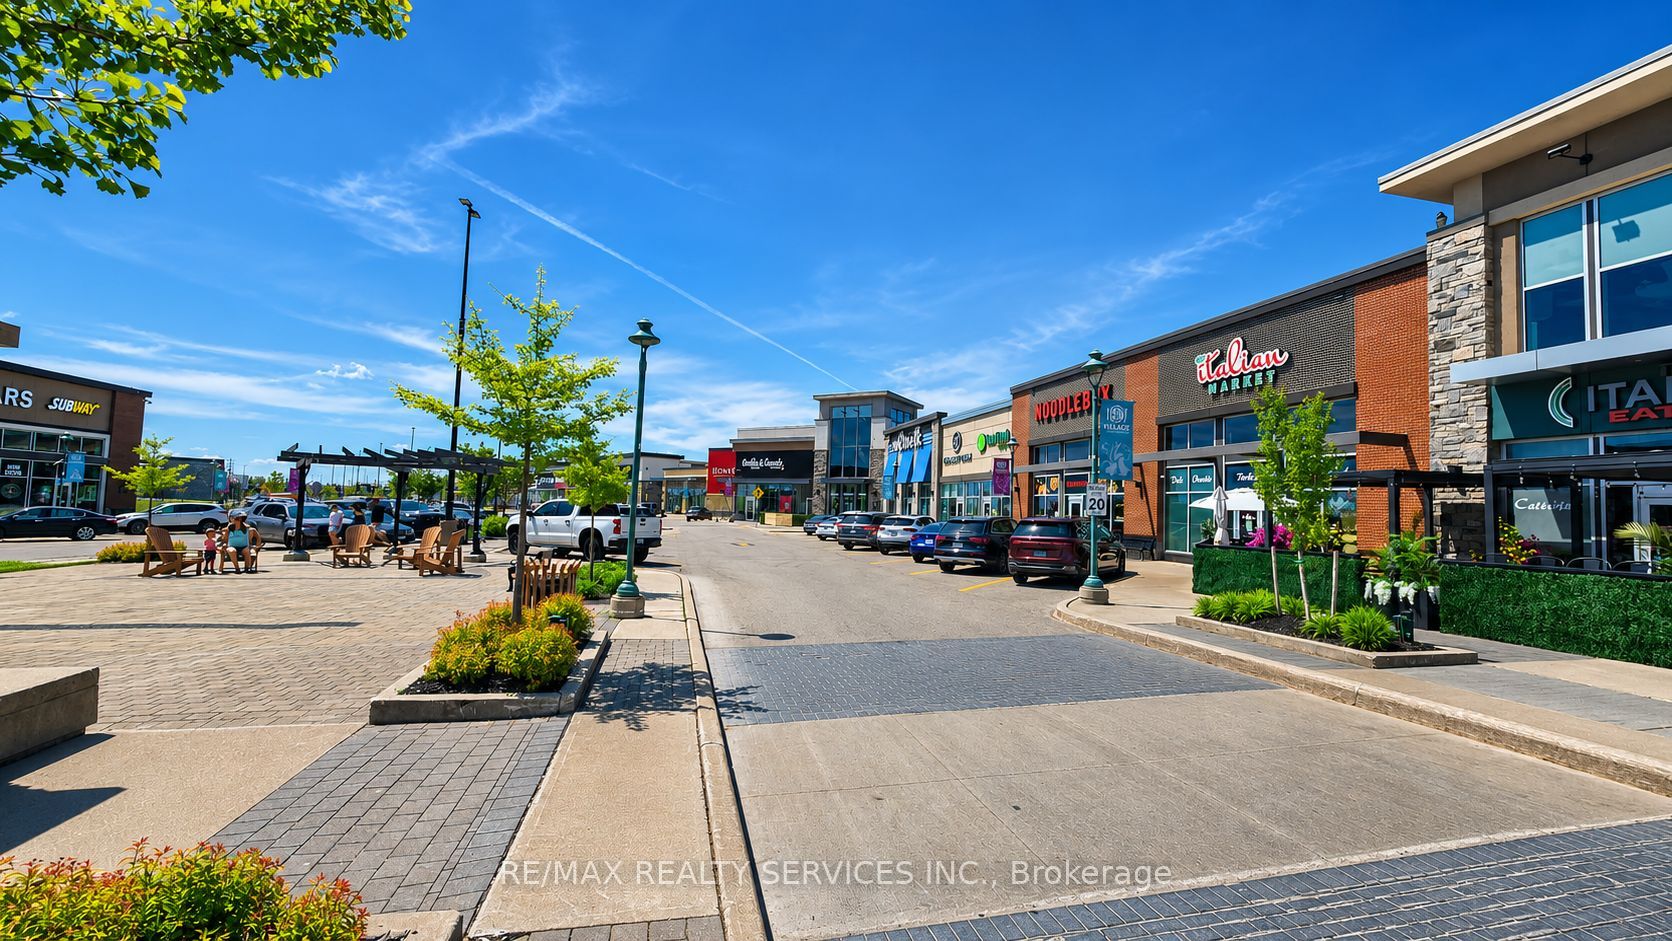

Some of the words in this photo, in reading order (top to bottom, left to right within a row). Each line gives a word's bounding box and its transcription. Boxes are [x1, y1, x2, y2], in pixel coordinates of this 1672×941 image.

[1208, 370, 1275, 395] MARKET
[0, 387, 33, 408] RS
[48, 397, 101, 415] SUBWAY
[1035, 384, 1110, 423] NOODLEBX
[1088, 498, 1105, 511] 20
